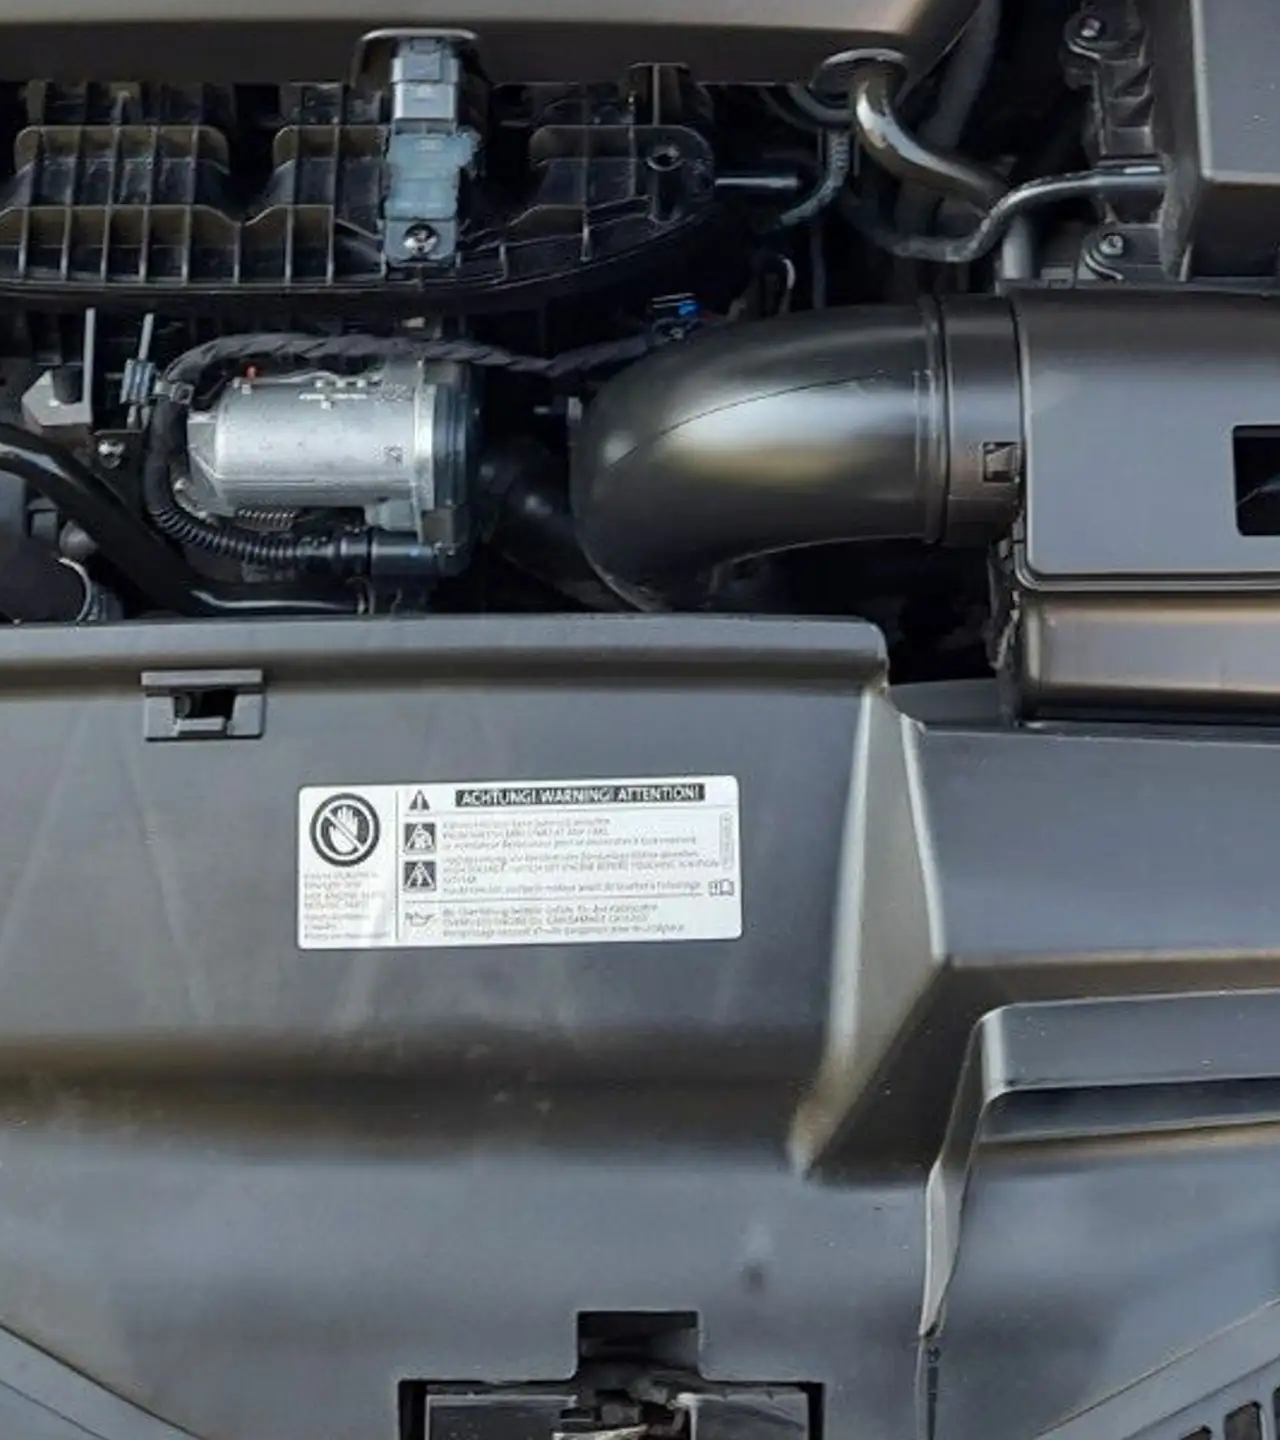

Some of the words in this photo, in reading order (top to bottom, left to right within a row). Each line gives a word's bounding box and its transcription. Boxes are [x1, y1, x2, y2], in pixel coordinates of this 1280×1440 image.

[461, 790, 535, 806] ACHTUNG!
[539, 788, 614, 804] WARNING!
[617, 784, 701, 802] ATTENTION!
